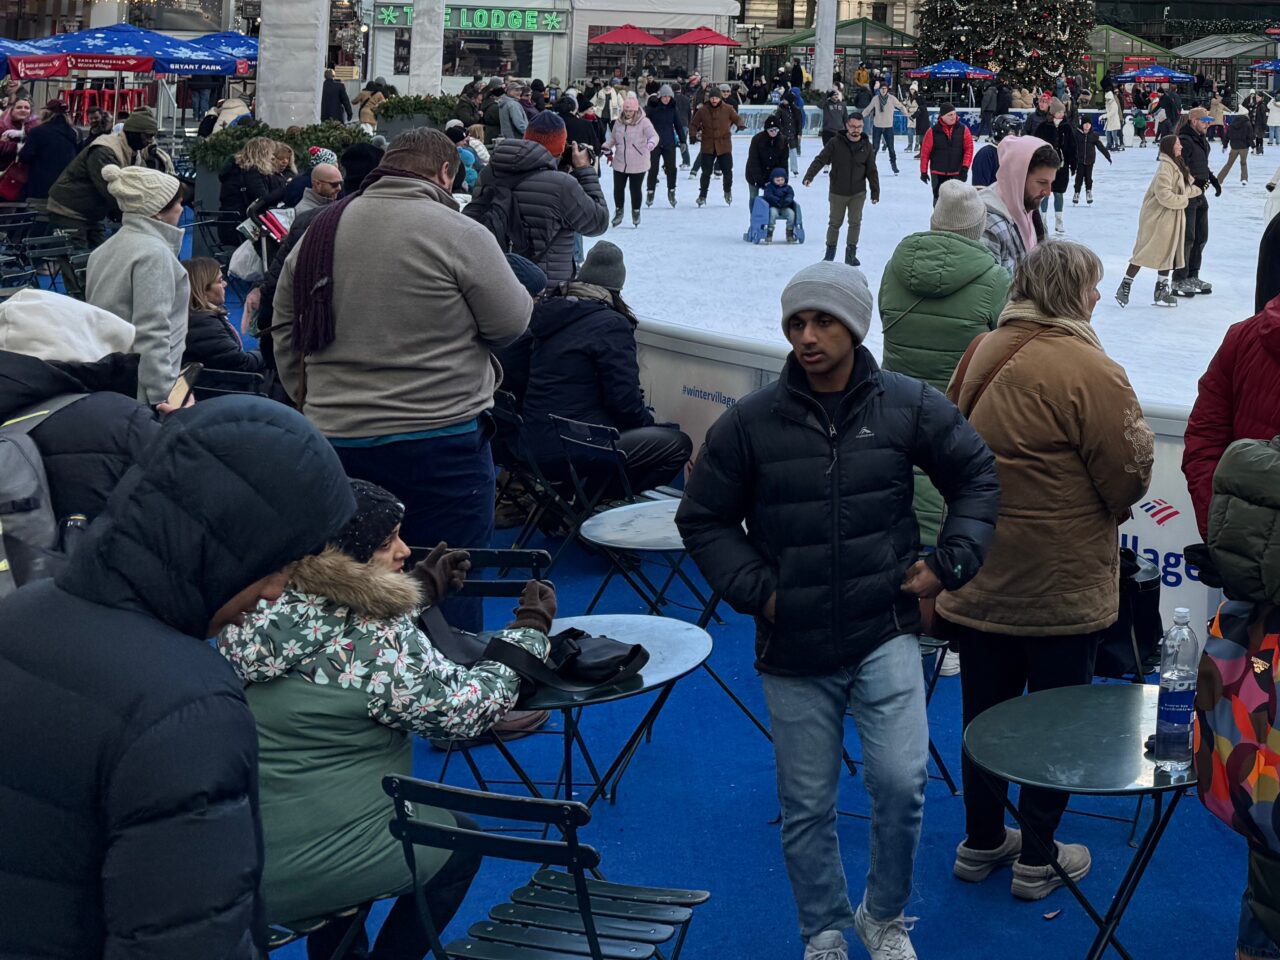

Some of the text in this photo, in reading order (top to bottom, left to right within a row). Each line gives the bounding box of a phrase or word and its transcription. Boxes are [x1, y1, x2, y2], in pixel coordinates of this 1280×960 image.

[403, 6, 538, 30] TE LODGE
[201, 63, 222, 71] PARK
